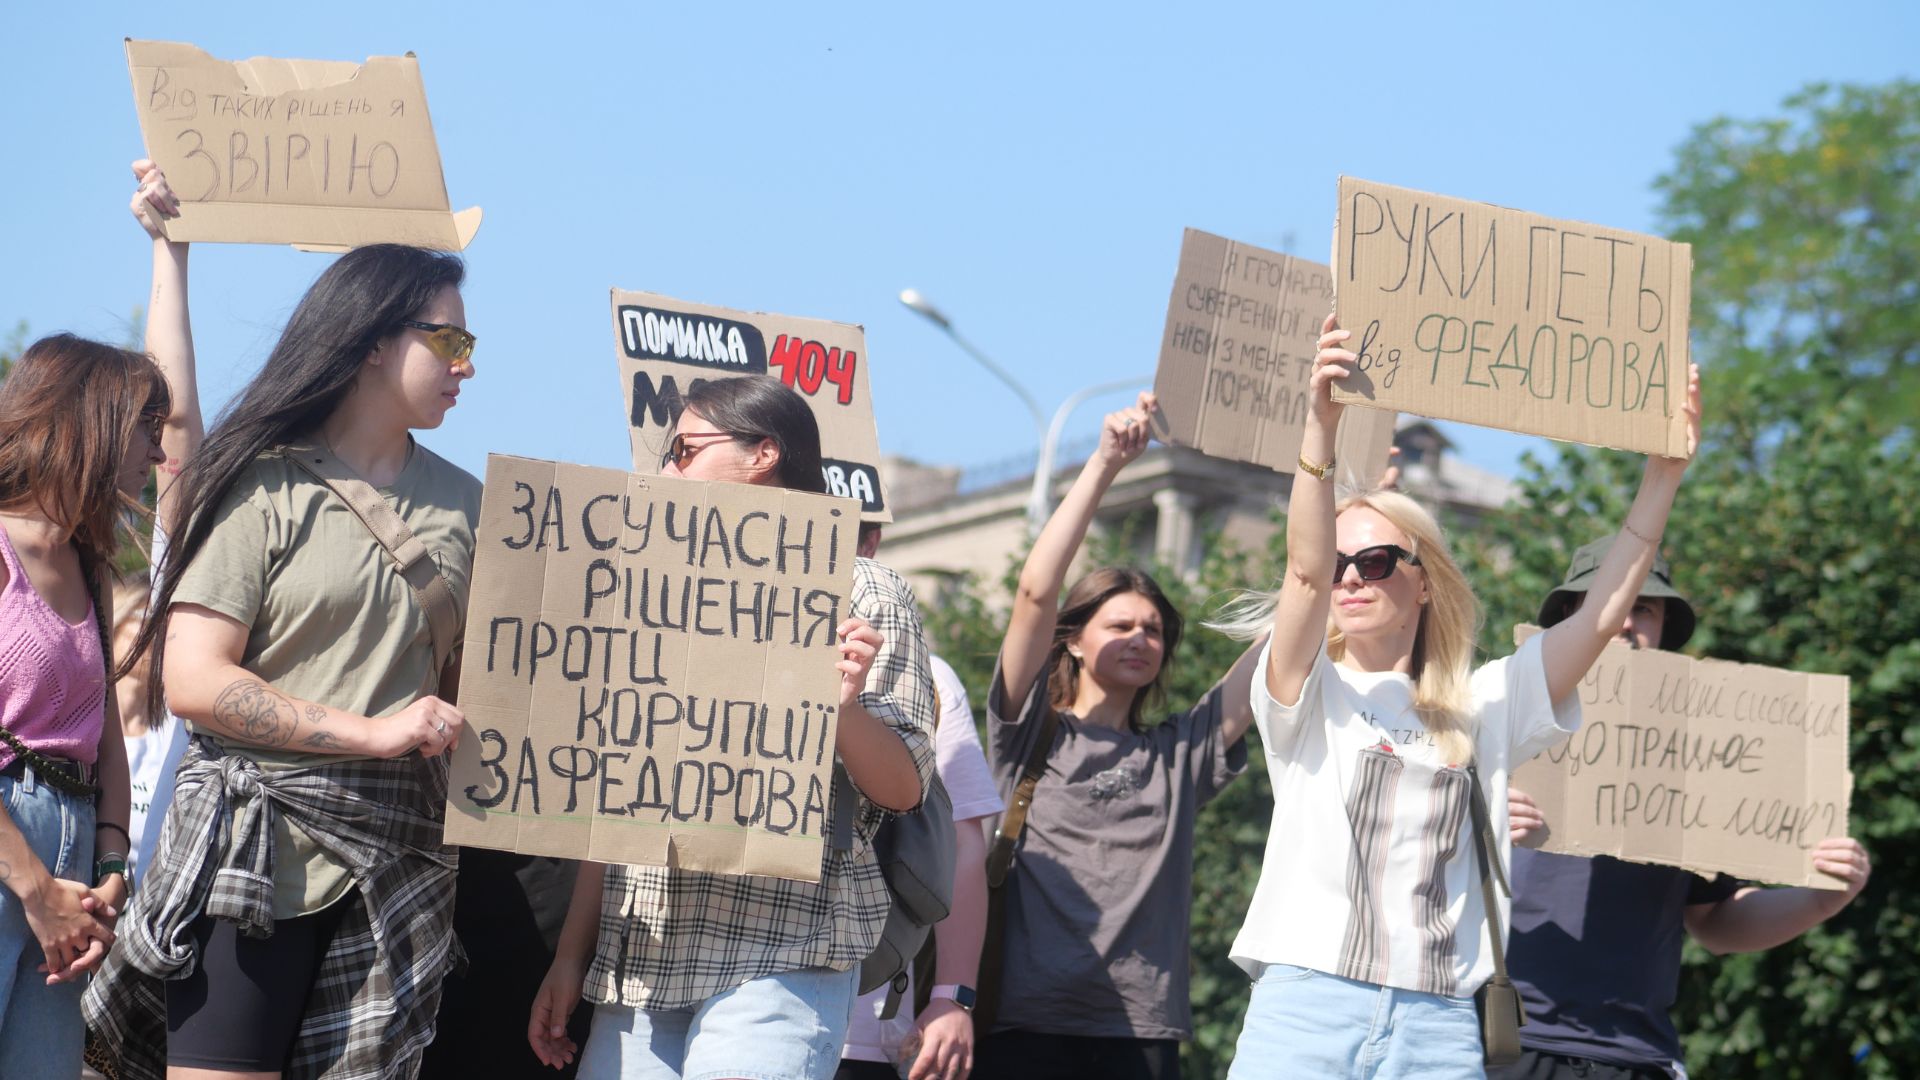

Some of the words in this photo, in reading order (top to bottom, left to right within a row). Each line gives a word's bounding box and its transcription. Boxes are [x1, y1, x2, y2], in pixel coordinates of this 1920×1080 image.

[208, 94, 276, 120] ТАКИХ
[287, 96, 373, 120] РІШЕНЬ
[390, 99, 406, 119] Я
[176, 128, 400, 203] ЗВІРІЮ
[1350, 192, 1497, 306] РУКИ
[1525, 225, 1665, 334] ГЕТЬ
[622, 309, 749, 365] ПОМИЛКА
[769, 333, 857, 406] 404
[1206, 367, 1308, 427] ПОРЖАЛ
[1239, 342, 1291, 378] МЕНЕ
[1356, 319, 1402, 390] від
[1414, 313, 1669, 418] ФЕДОРОВА
[502, 480, 570, 553] ЗА
[581, 493, 843, 576] СУЧАСНІ
[583, 558, 842, 648] РІШЕННЯ
[577, 686, 835, 766] КОРУПЦІЇ
[1615, 723, 1766, 773] ПРАЦЮЄ
